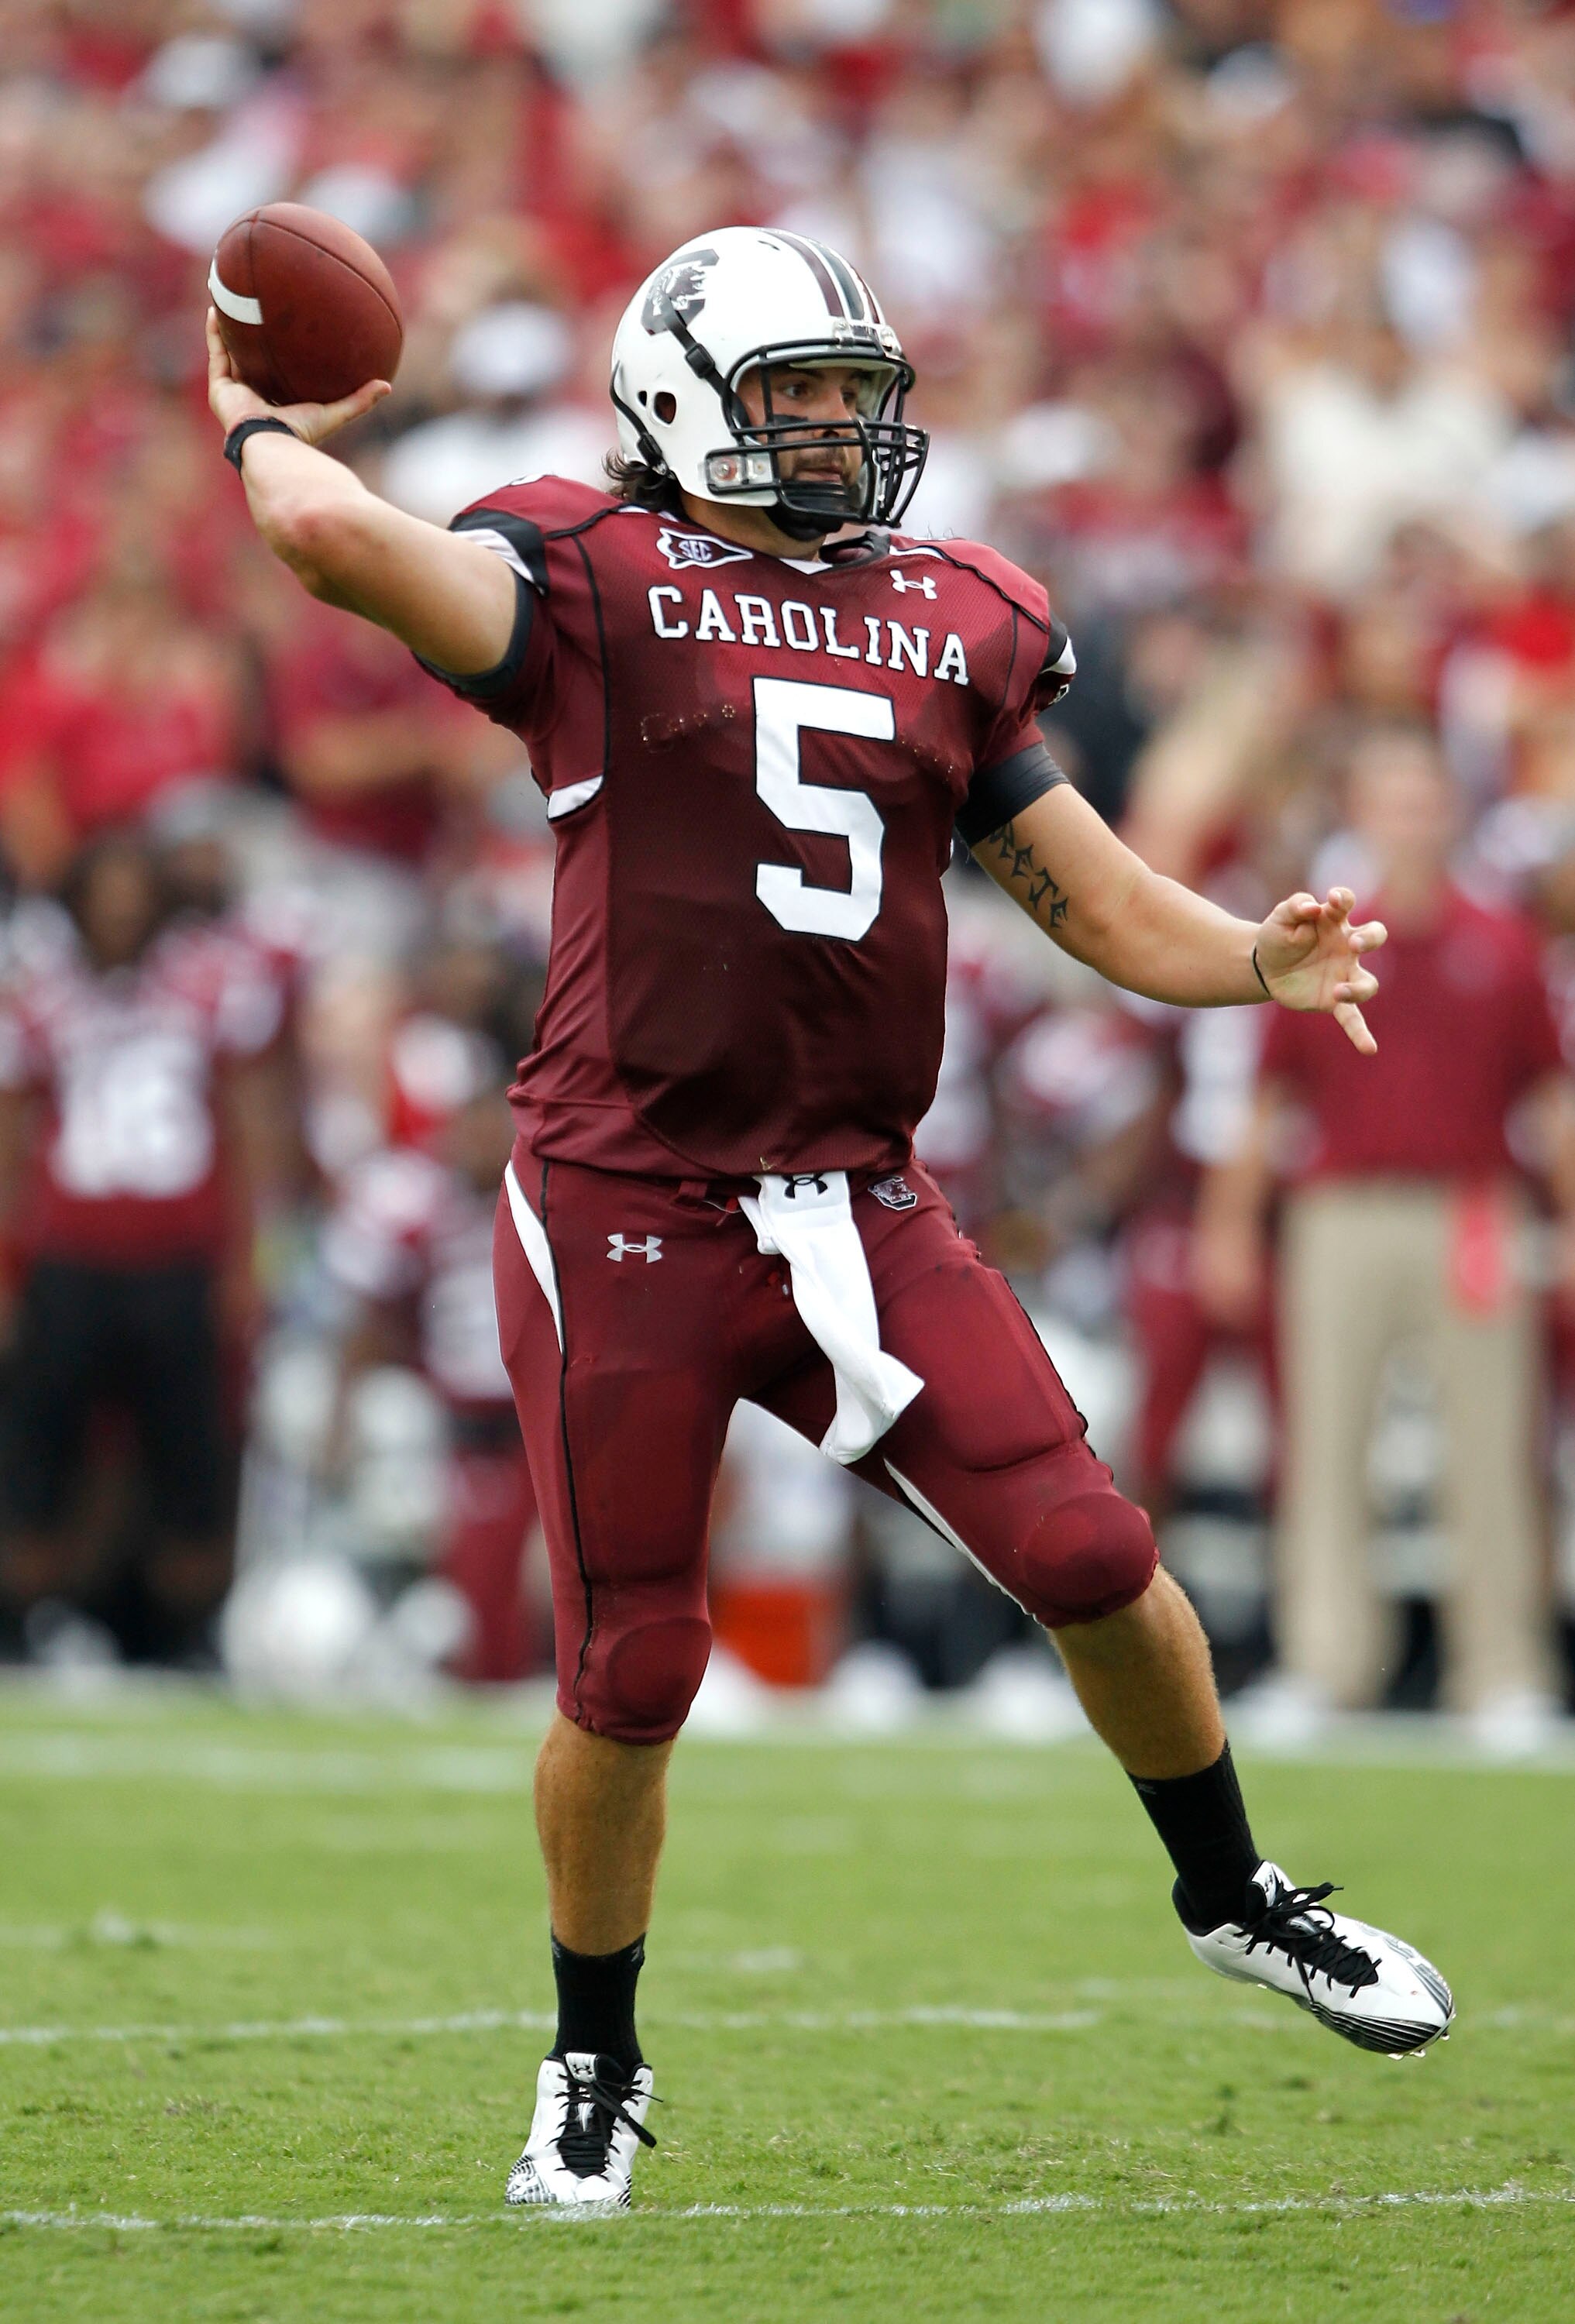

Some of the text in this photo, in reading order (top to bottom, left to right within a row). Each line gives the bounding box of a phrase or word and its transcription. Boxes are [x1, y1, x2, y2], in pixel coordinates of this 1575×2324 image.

[678, 540, 713, 562] SEC
[648, 585, 970, 686] CAROLINA
[752, 676, 896, 942] 5
